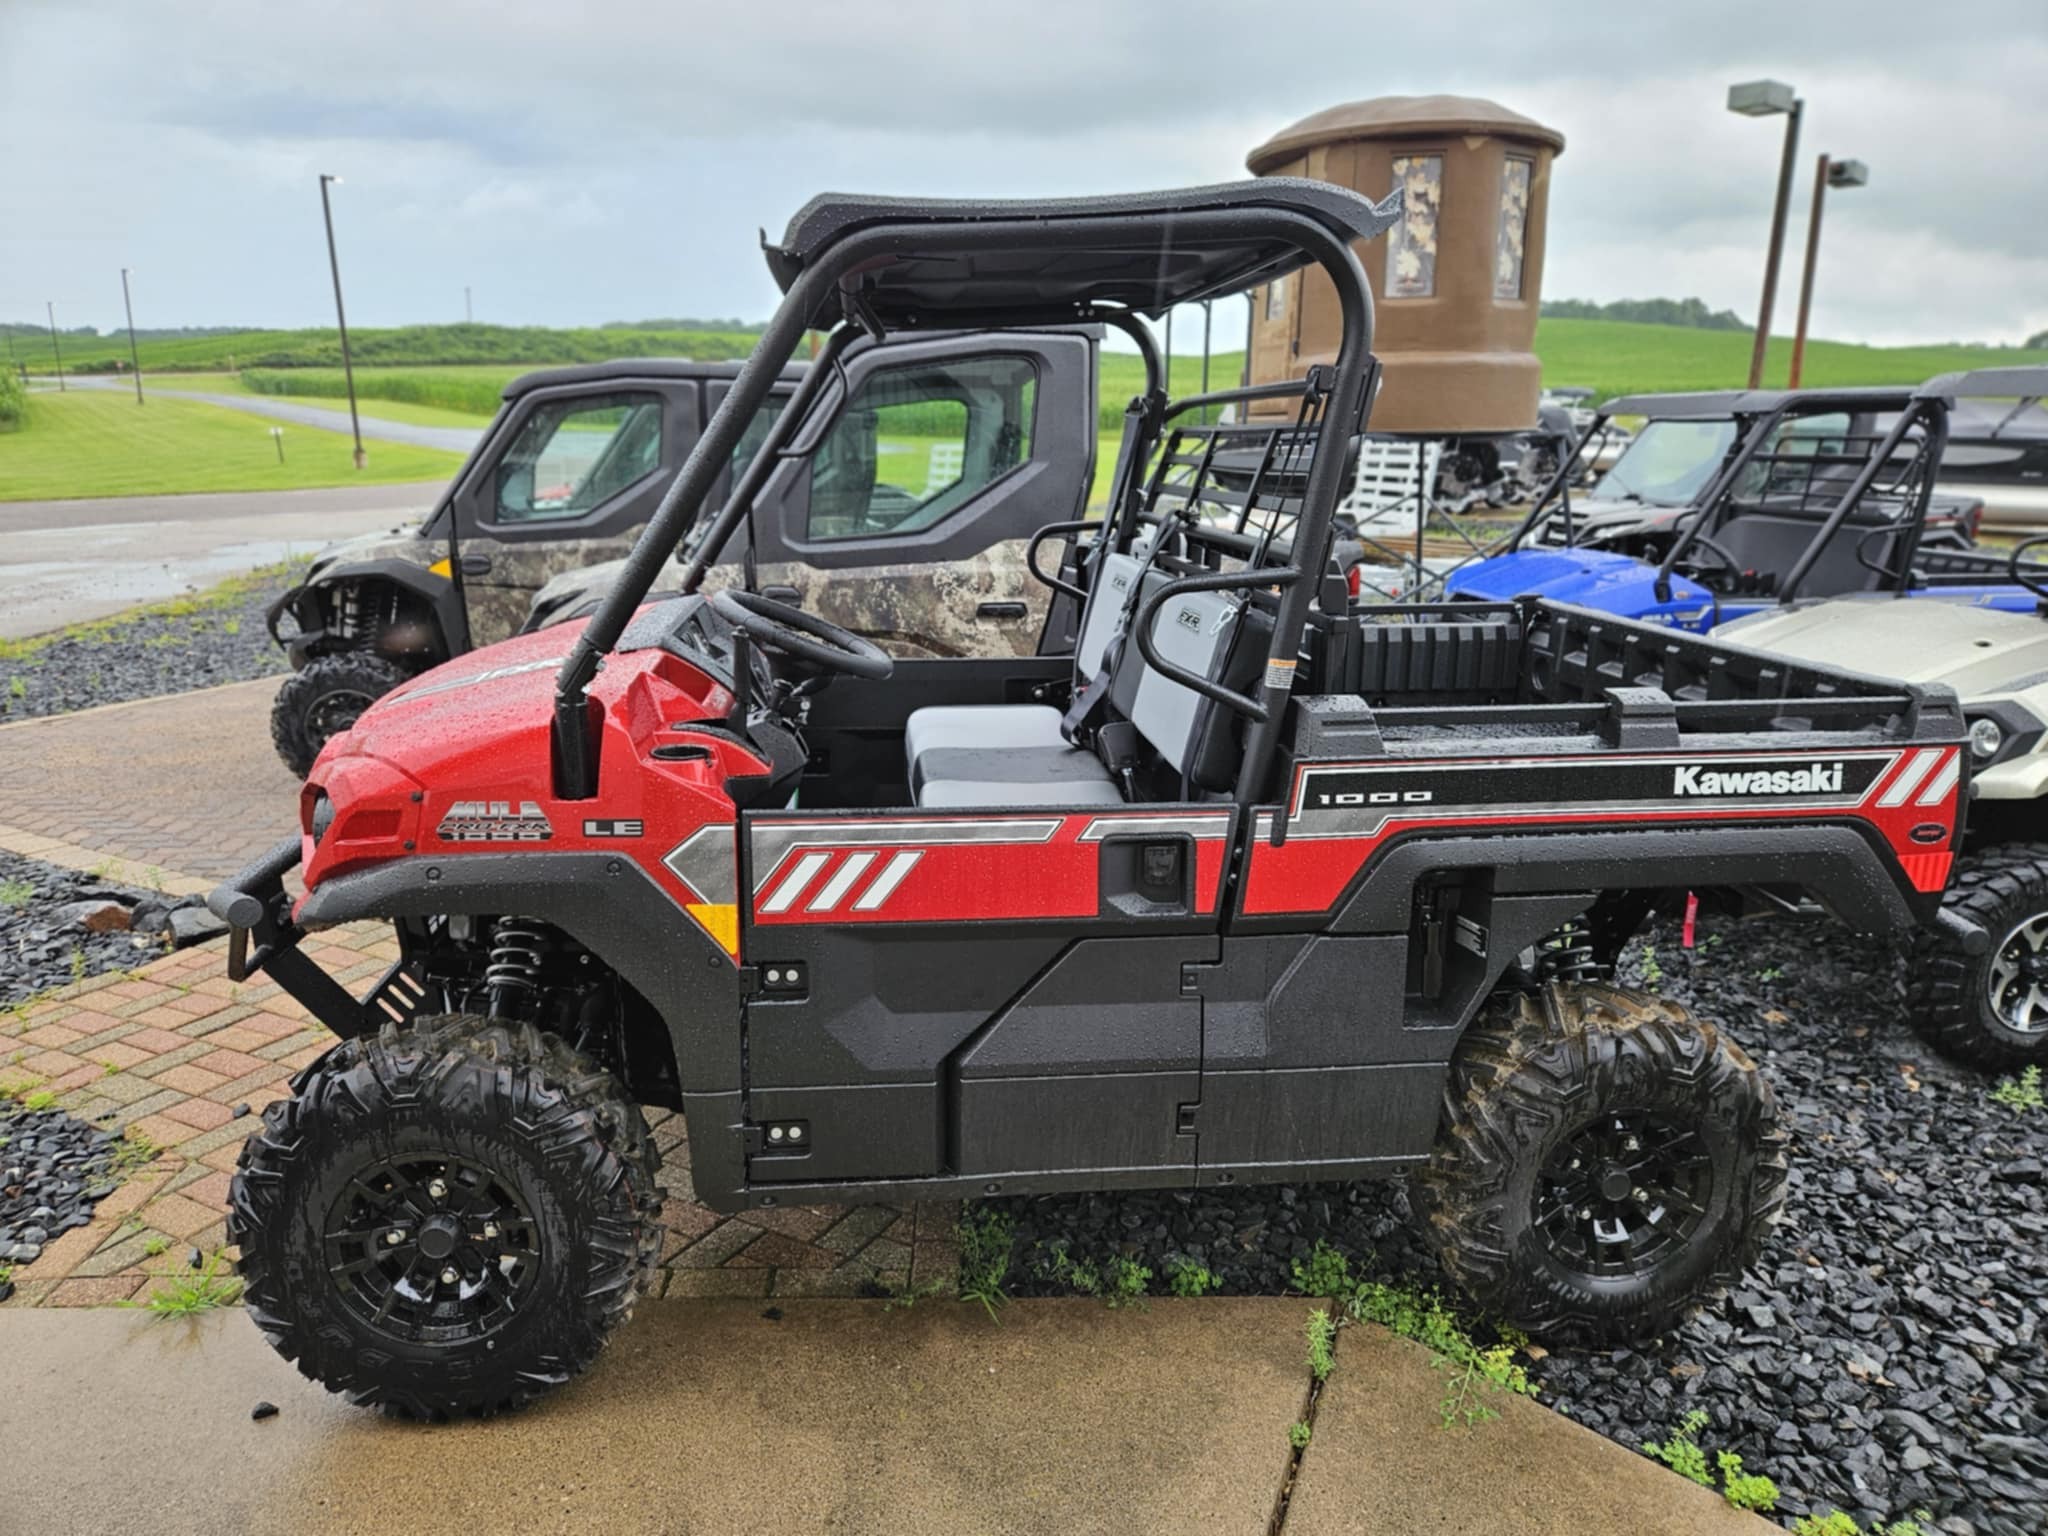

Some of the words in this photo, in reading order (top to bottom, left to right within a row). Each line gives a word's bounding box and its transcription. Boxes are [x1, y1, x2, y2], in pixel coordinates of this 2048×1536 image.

[1673, 762, 1844, 796] Kawasaki
[1319, 791, 1432, 805] 1000
[584, 821, 642, 836] LE
